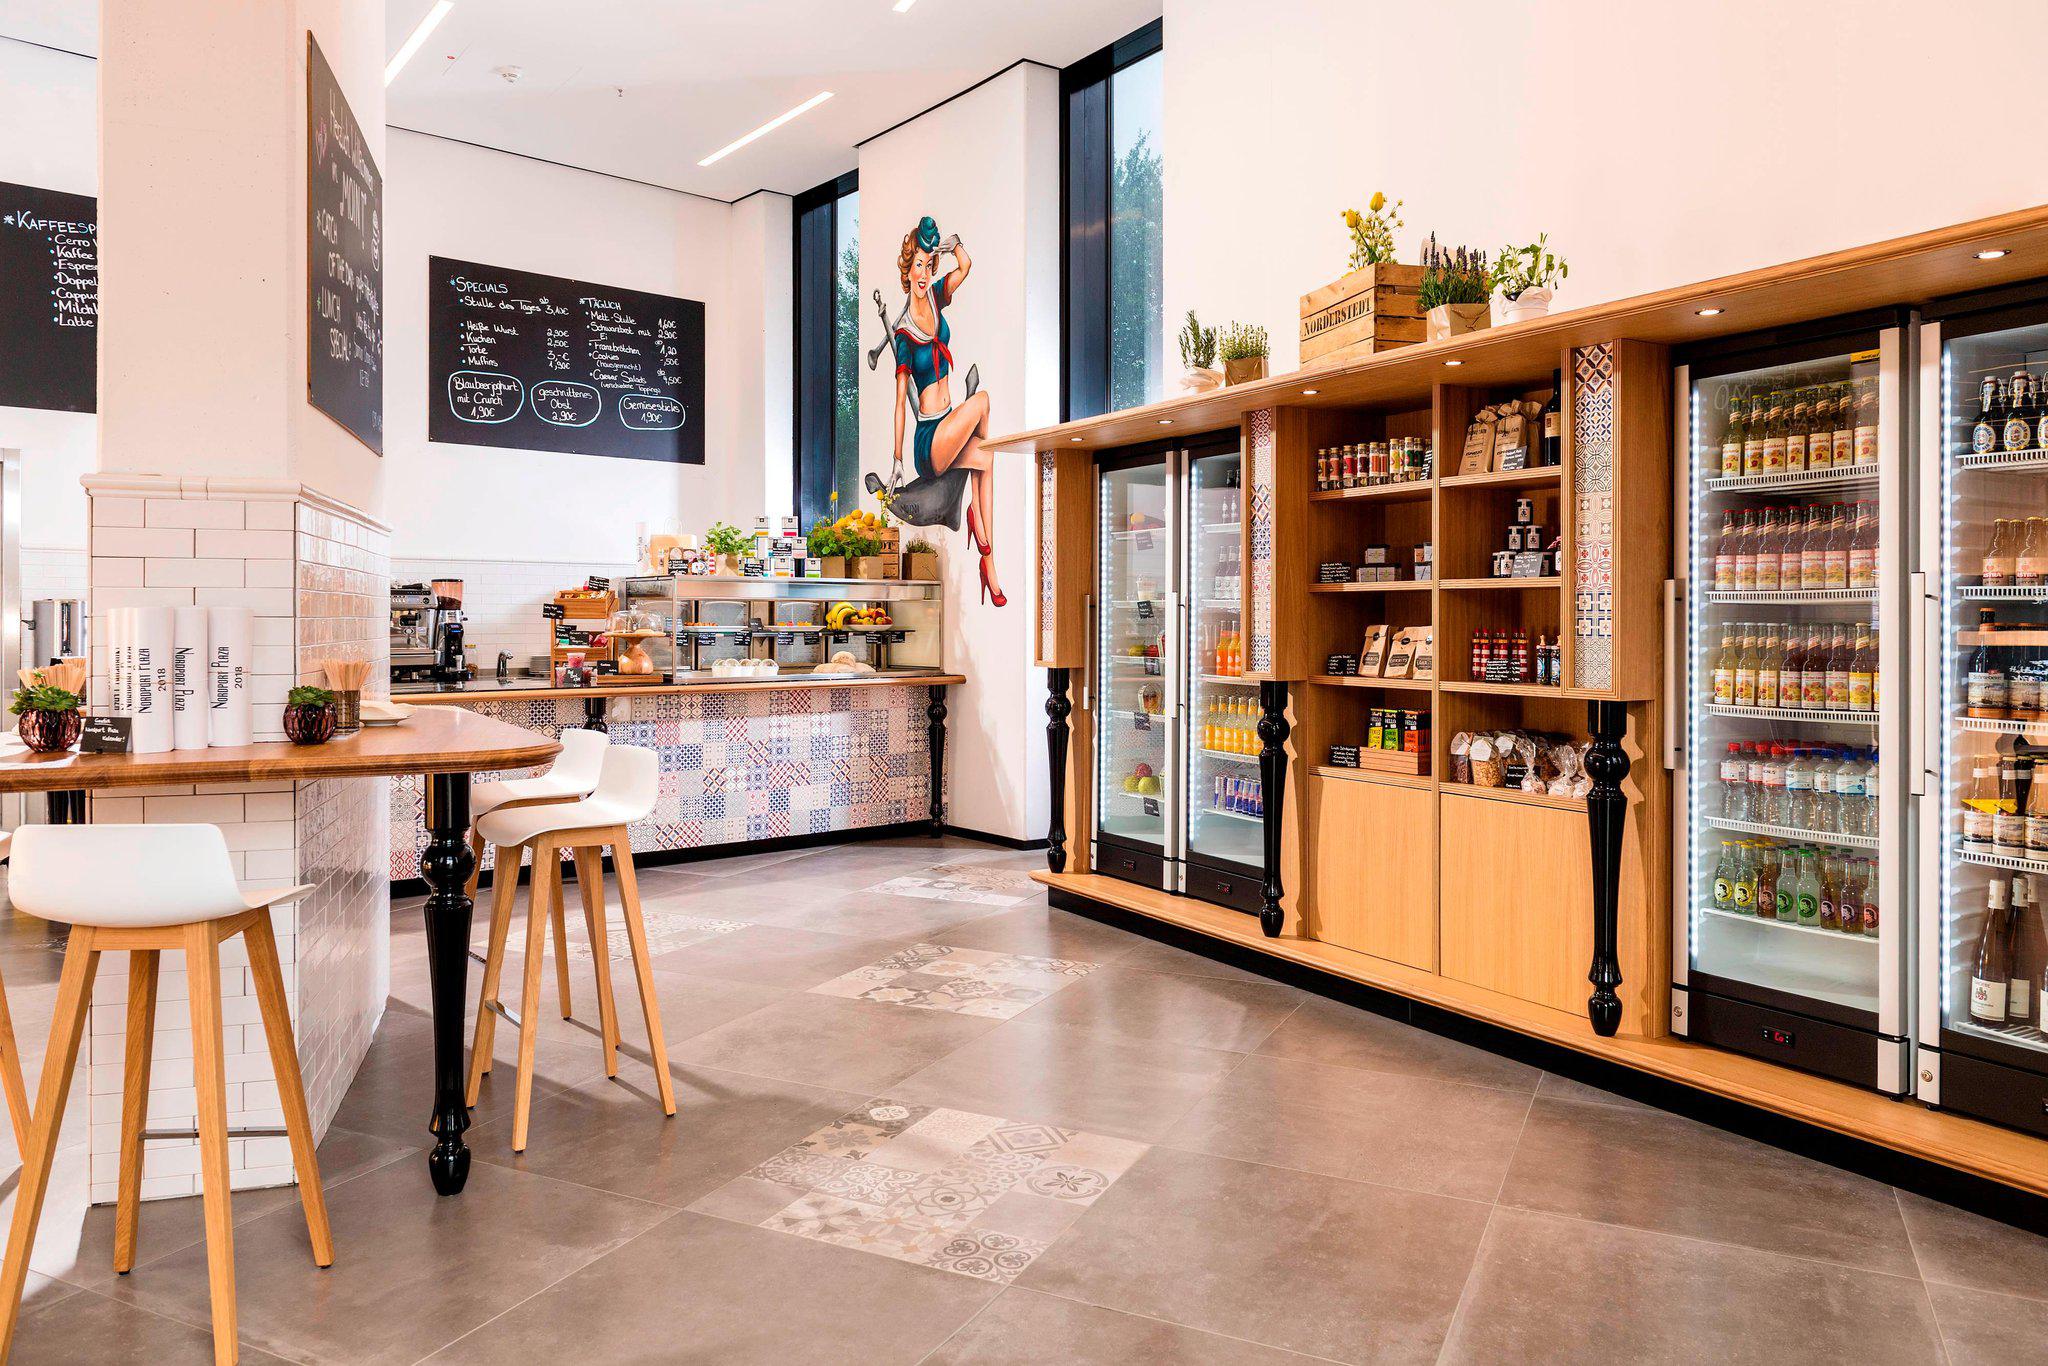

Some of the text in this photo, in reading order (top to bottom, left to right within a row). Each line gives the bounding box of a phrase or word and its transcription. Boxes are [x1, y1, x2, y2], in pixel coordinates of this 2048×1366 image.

[17, 211, 97, 234] KAFFEESP
[55, 234, 90, 247] Cerro
[57, 245, 95, 260] Kaffee
[456, 276, 508, 294] SPECIALS
[465, 296, 495, 309] Stulle
[511, 299, 541, 315] Tages
[59, 313, 95, 328] Latte
[1303, 296, 1371, 338] NORDERSTEDT
[494, 324, 519, 336] Wurst
[638, 329, 652, 337] mit
[466, 332, 570, 348] Kuchen 2,50€
[463, 343, 489, 355] Torte
[592, 351, 620, 361] Cookies
[467, 356, 499, 367] Muffins
[453, 377, 520, 396] Blaubeerjoghurt
[538, 387, 593, 401] geschnittenes
[457, 393, 504, 406] mit Crunch
[550, 400, 573, 410] Obst
[470, 406, 495, 418] 1,90€
[552, 411, 577, 421] 2,90€
[158, 668, 166, 692] 2018
[174, 647, 194, 712] NORDPORT PLAZA
[211, 646, 230, 710] NORDPORT PLAZA
[234, 666, 243, 689] 2018
